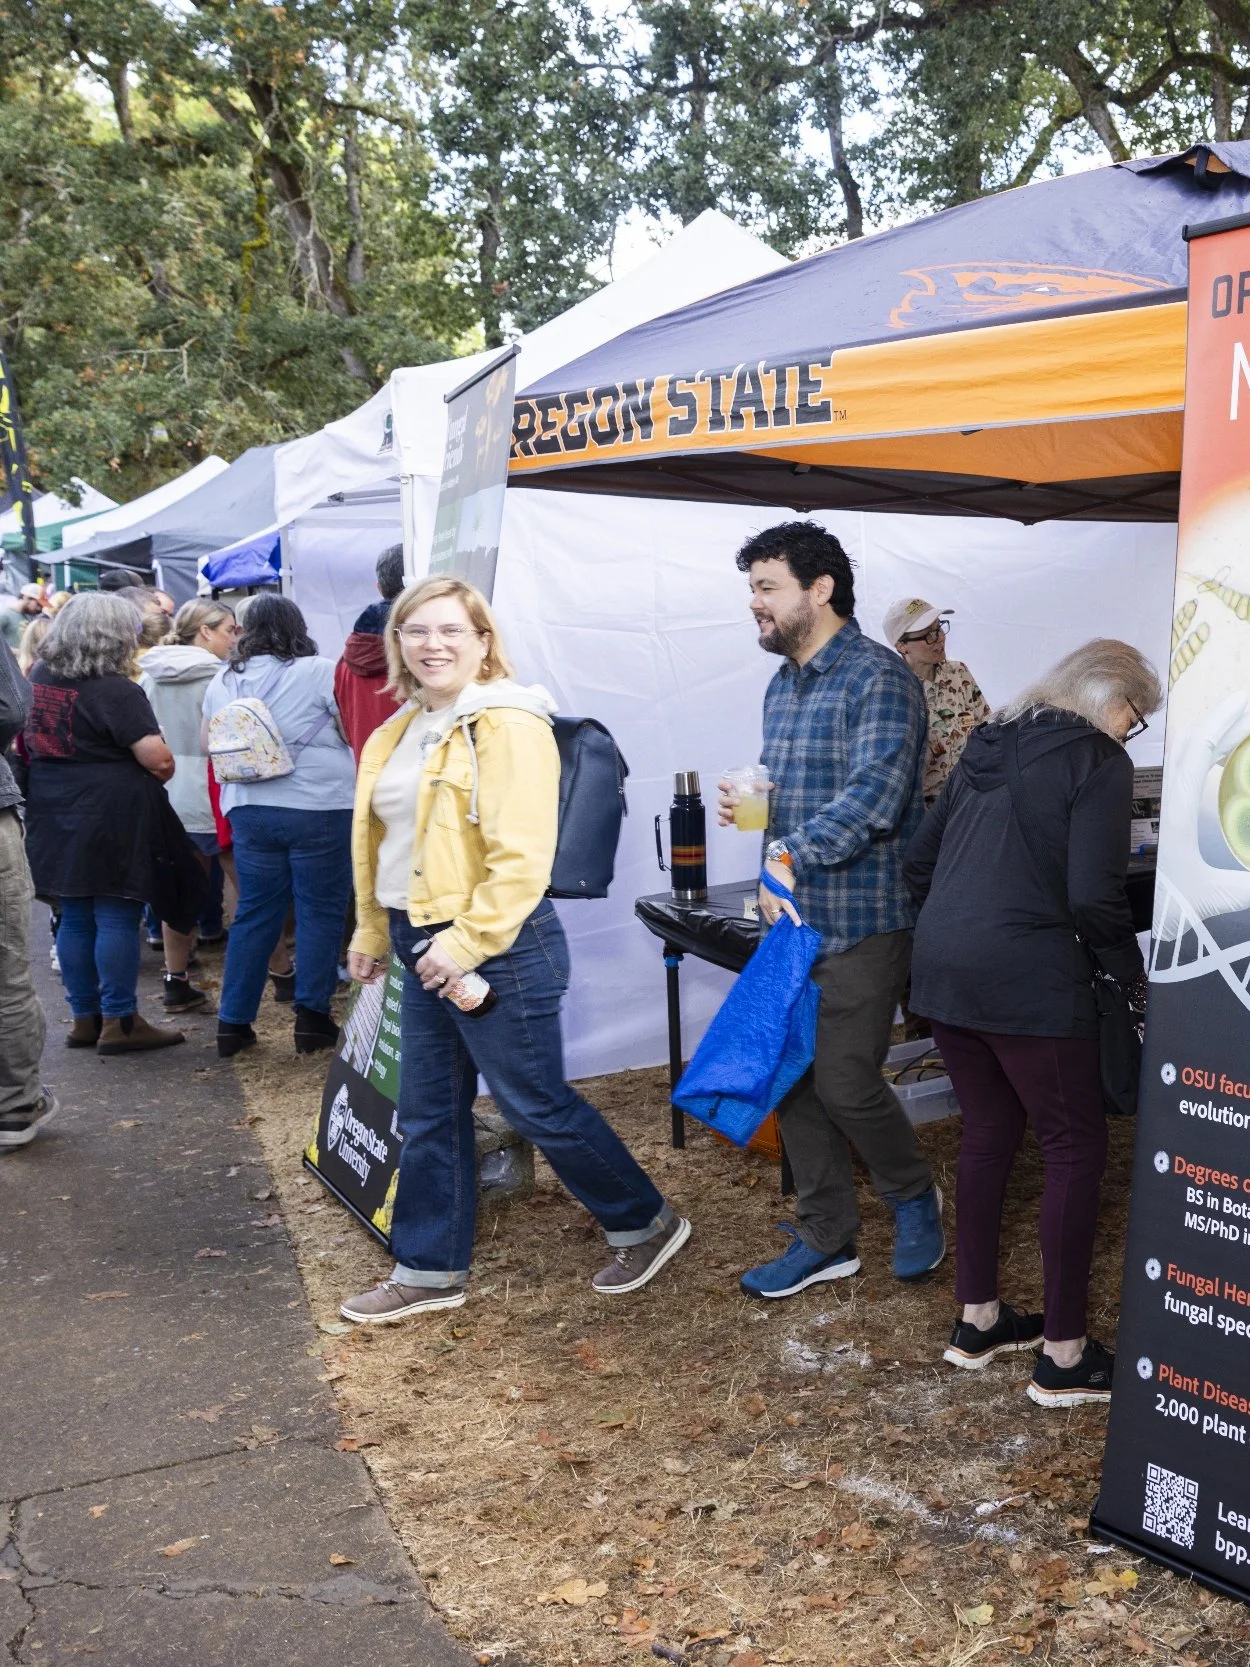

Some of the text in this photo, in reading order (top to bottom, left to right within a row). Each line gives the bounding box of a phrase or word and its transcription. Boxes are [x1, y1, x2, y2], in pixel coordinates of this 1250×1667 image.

[509, 379, 654, 460] REGON
[668, 363, 833, 438] STATE
[1181, 1067, 1215, 1091] OSU
[345, 1108, 388, 1163] Oregon State
[338, 1132, 371, 1187] University
[1174, 1156, 1238, 1190] Degrees
[1186, 1186, 1203, 1205] BS
[1207, 1192, 1219, 1210] in
[1185, 1211, 1239, 1242] MS/PhD
[1167, 1263, 1219, 1297] Fungal
[1164, 1292, 1213, 1326] fungal
[1159, 1363, 1199, 1396] Plant
[1155, 1394, 1199, 1425] 2,000
[1203, 1414, 1245, 1445] plant
